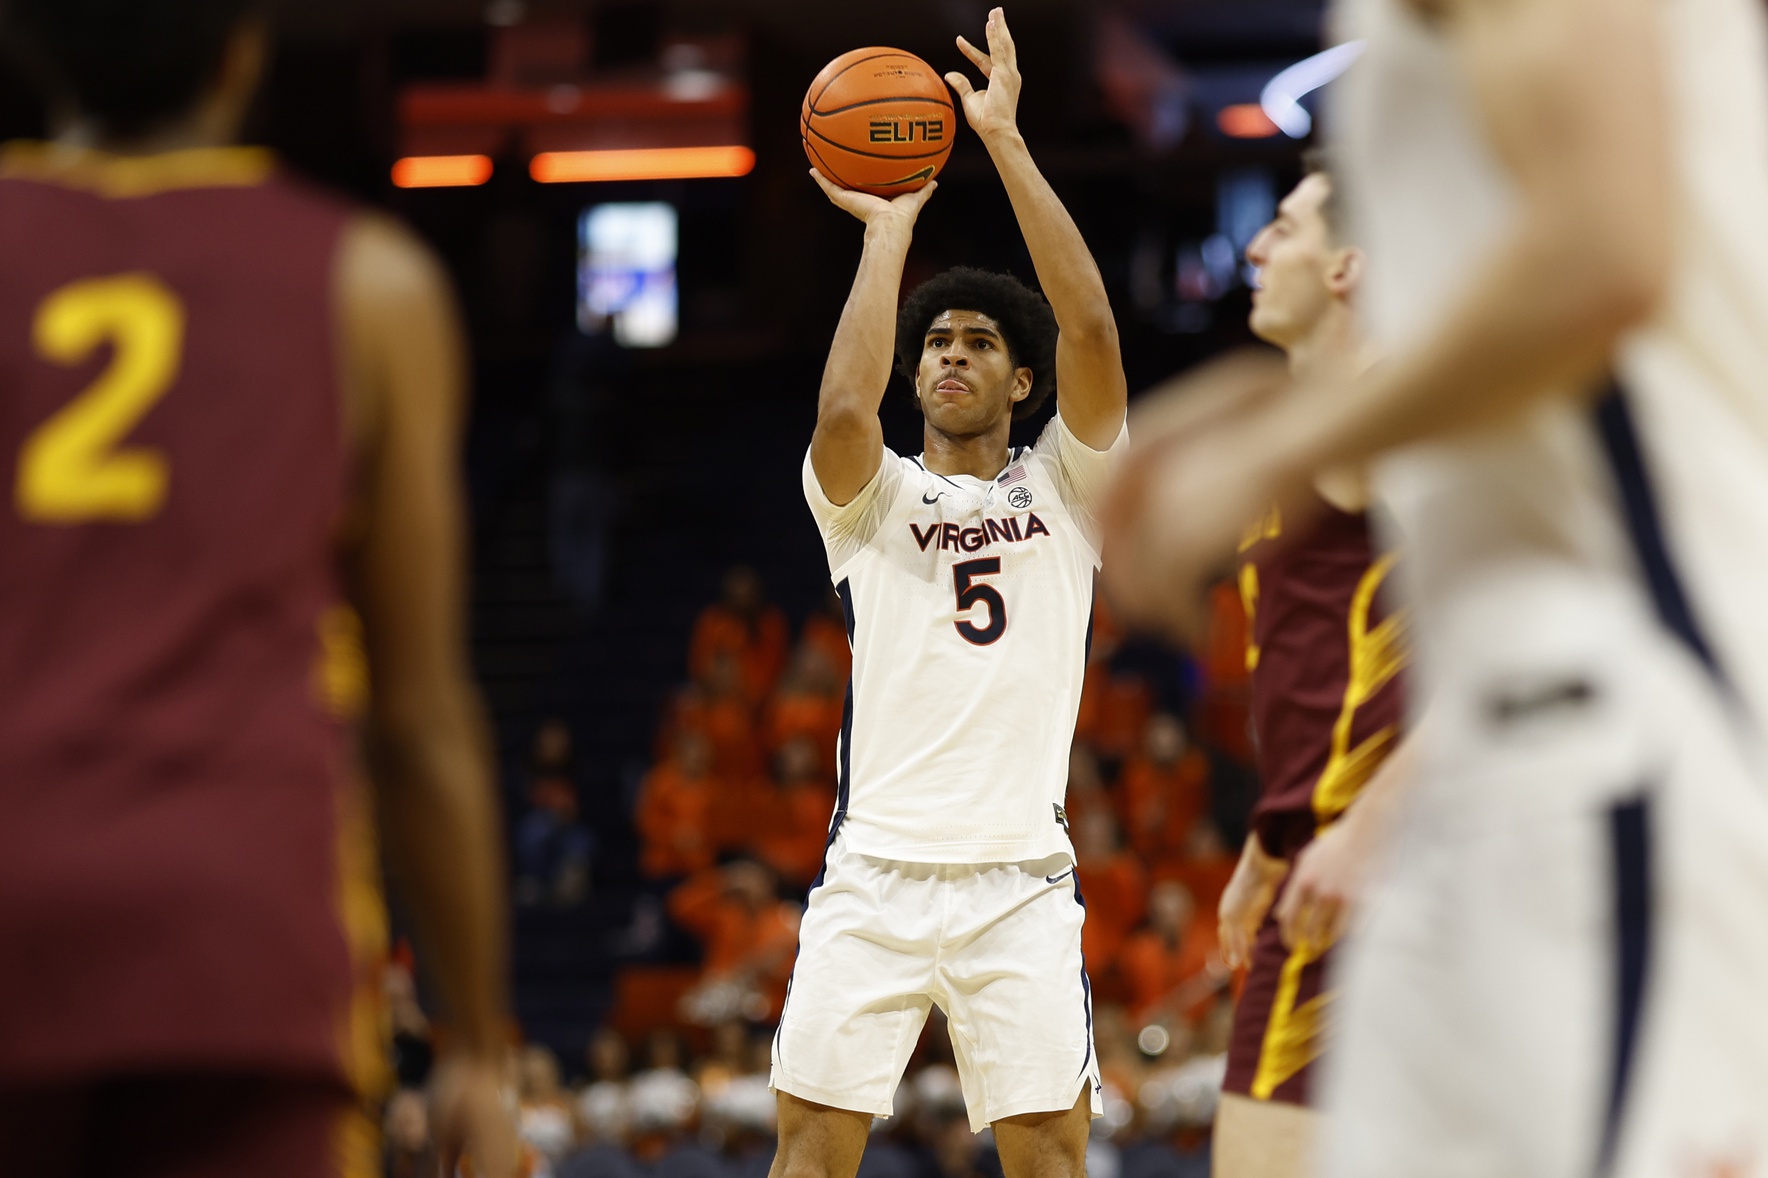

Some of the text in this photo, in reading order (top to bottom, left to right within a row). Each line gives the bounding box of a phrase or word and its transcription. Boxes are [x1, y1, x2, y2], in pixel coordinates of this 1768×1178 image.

[869, 120, 944, 143] ELITE
[16, 271, 185, 523] 2
[909, 511, 1051, 553] VIRGINIA
[952, 556, 1008, 646] 5
